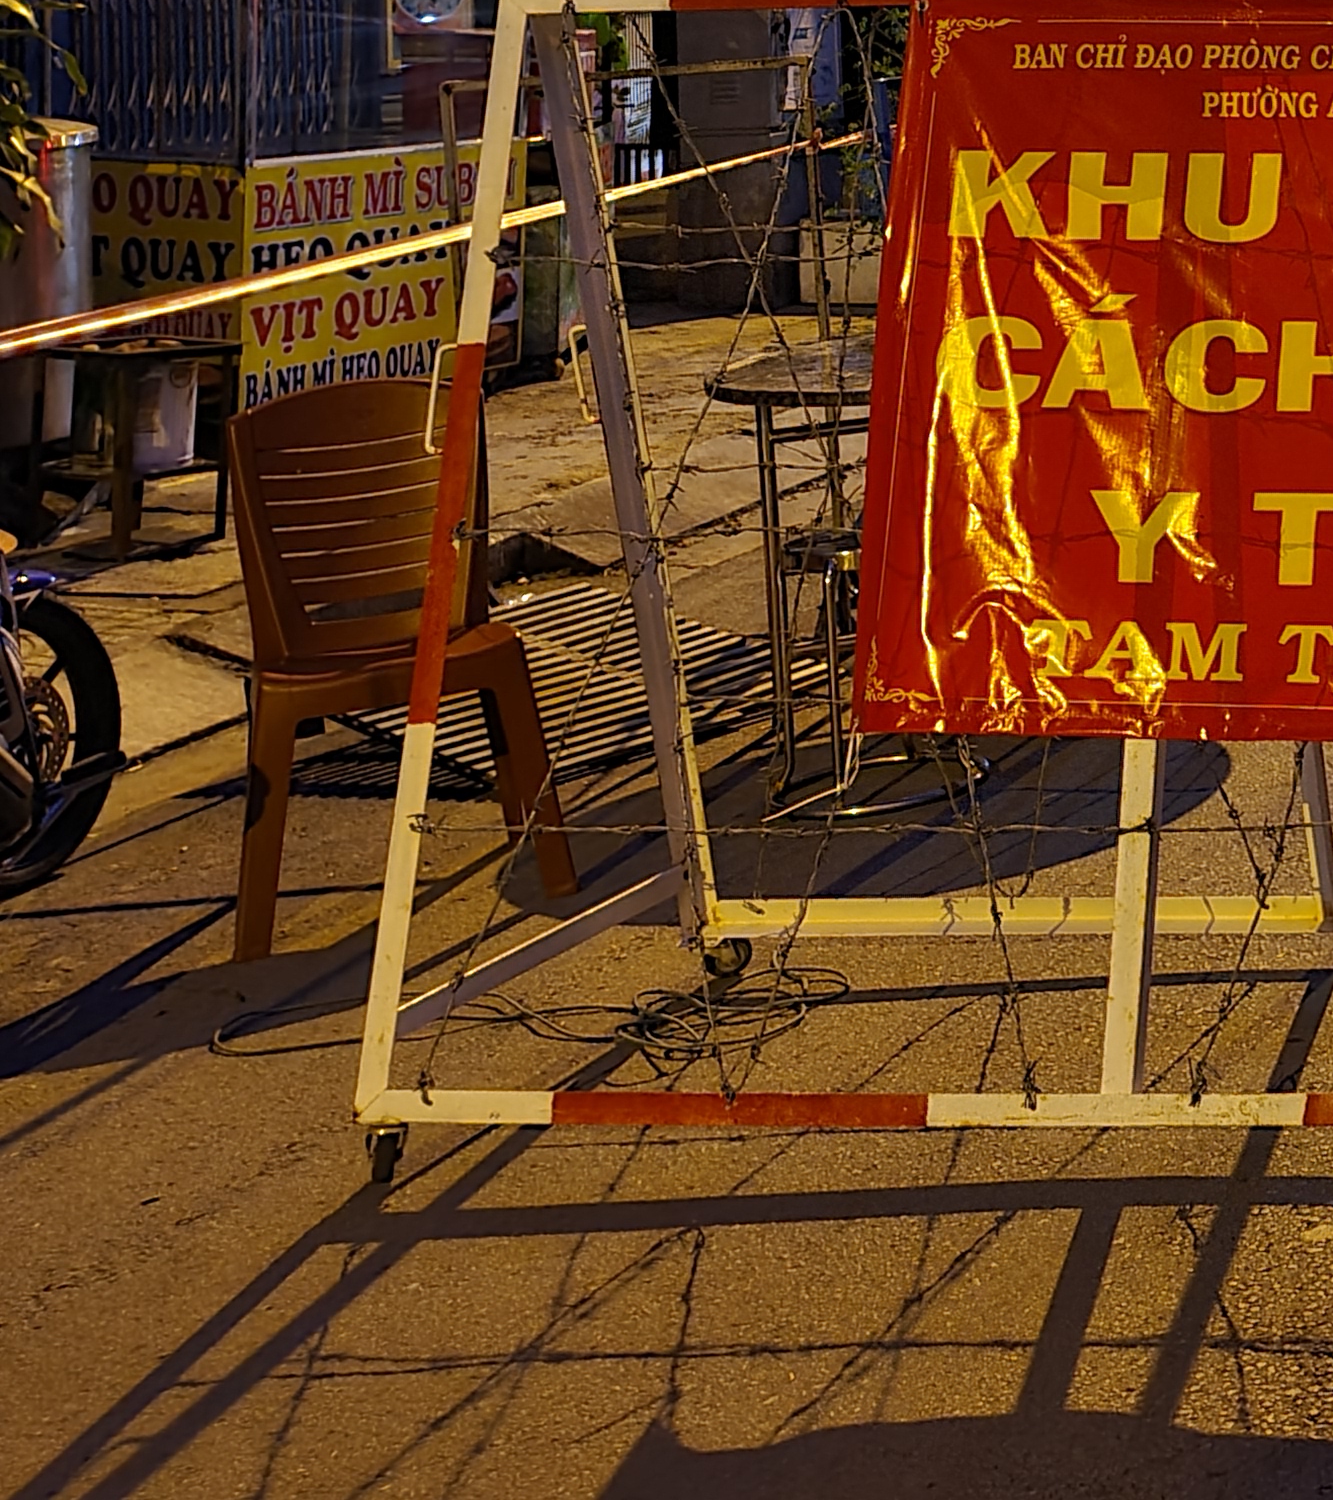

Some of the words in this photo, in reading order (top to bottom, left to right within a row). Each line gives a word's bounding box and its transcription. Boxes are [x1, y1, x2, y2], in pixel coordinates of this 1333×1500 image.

[1013, 44, 1068, 69] BAN
[1076, 34, 1127, 69] CHỈ
[1135, 44, 1193, 75] ĐẠO
[1202, 38, 1300, 69] PHÒNG
[1203, 84, 1318, 118] PHƯỜNG
[129, 174, 239, 226] QUAY
[254, 167, 353, 231] BÁNH
[363, 157, 405, 218] MÌ
[947, 149, 1284, 243] KHU
[121, 237, 235, 289] QUAY
[250, 297, 323, 354] VỊT
[335, 278, 445, 341] QUAY
[245, 360, 307, 409] BÁNH
[312, 349, 335, 386] MÌ
[342, 349, 380, 381] HEO
[1090, 489, 1202, 584] Y
